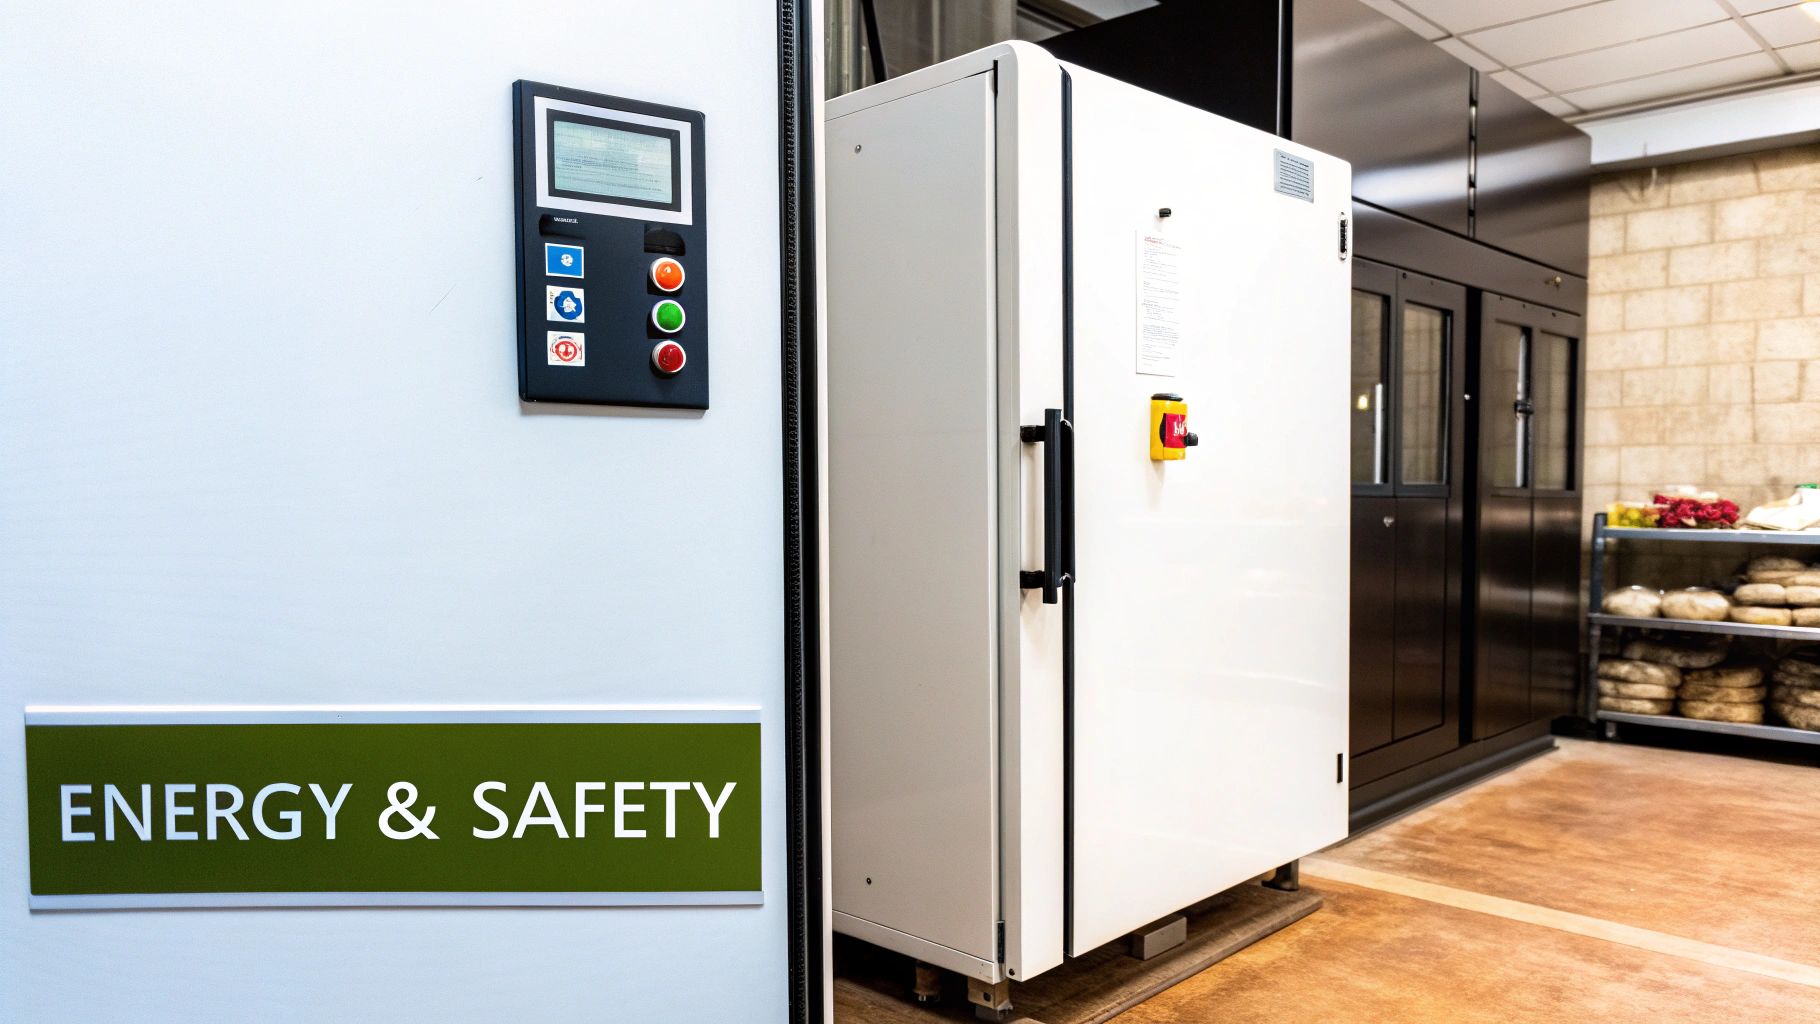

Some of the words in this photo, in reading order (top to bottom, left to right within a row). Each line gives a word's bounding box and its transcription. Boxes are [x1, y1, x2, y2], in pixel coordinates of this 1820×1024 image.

[60, 782, 353, 841] ENERGY
[378, 781, 440, 839] &
[472, 781, 737, 838] SAFETY
